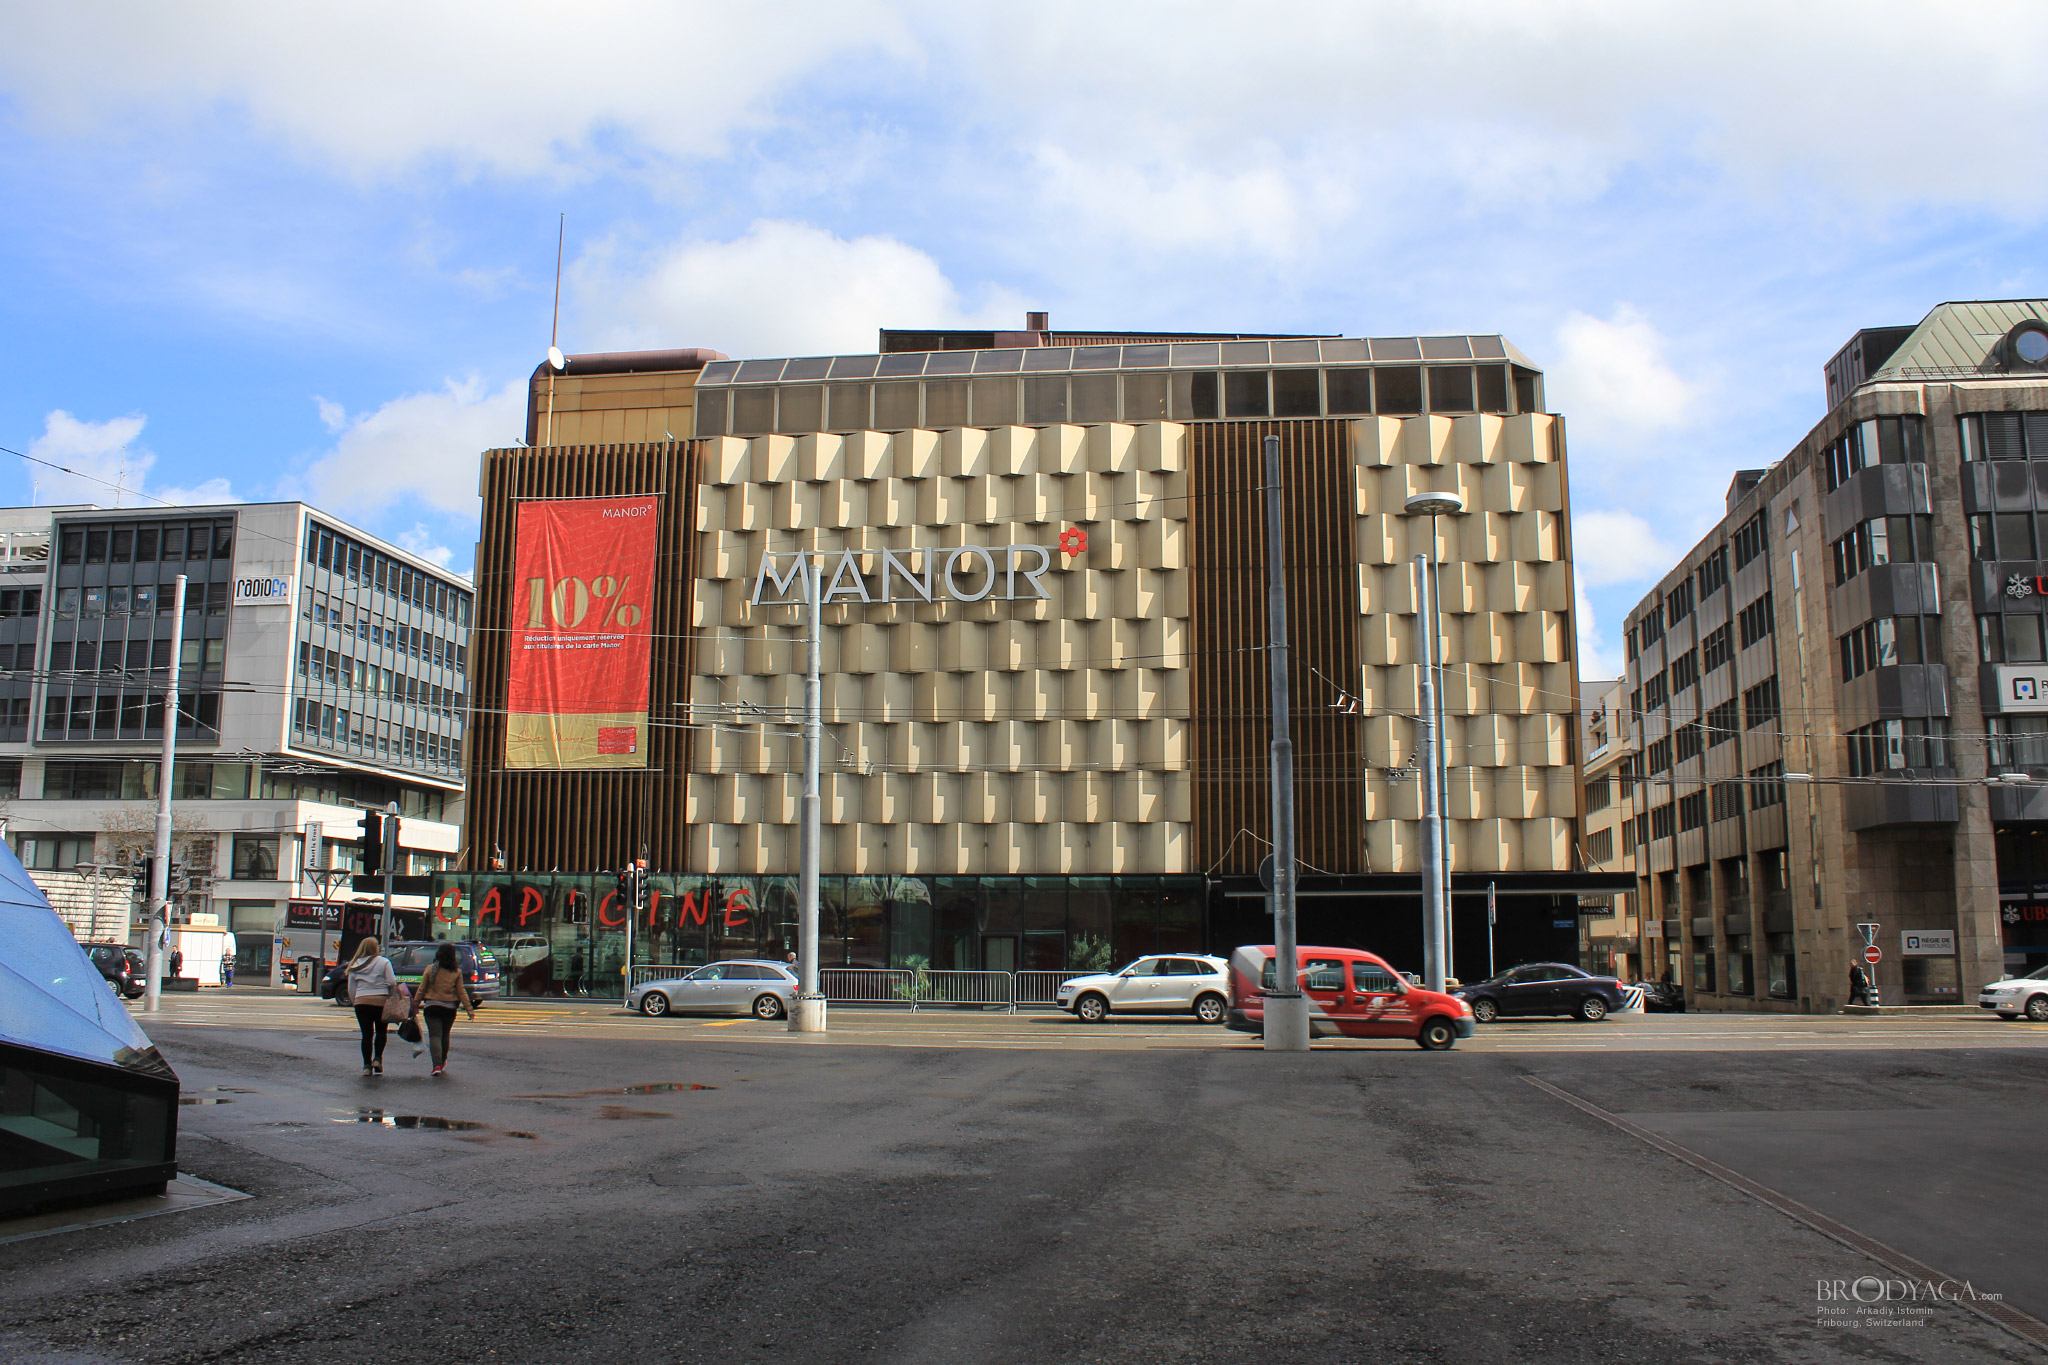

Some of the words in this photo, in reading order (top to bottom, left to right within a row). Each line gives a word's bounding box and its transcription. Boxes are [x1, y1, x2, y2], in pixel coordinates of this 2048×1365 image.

[602, 506, 647, 518] MANOR
[751, 544, 1051, 606] MANOR
[524, 575, 642, 629] 10%
[557, 635, 596, 644] uniquement
[600, 641, 621, 649] Manor
